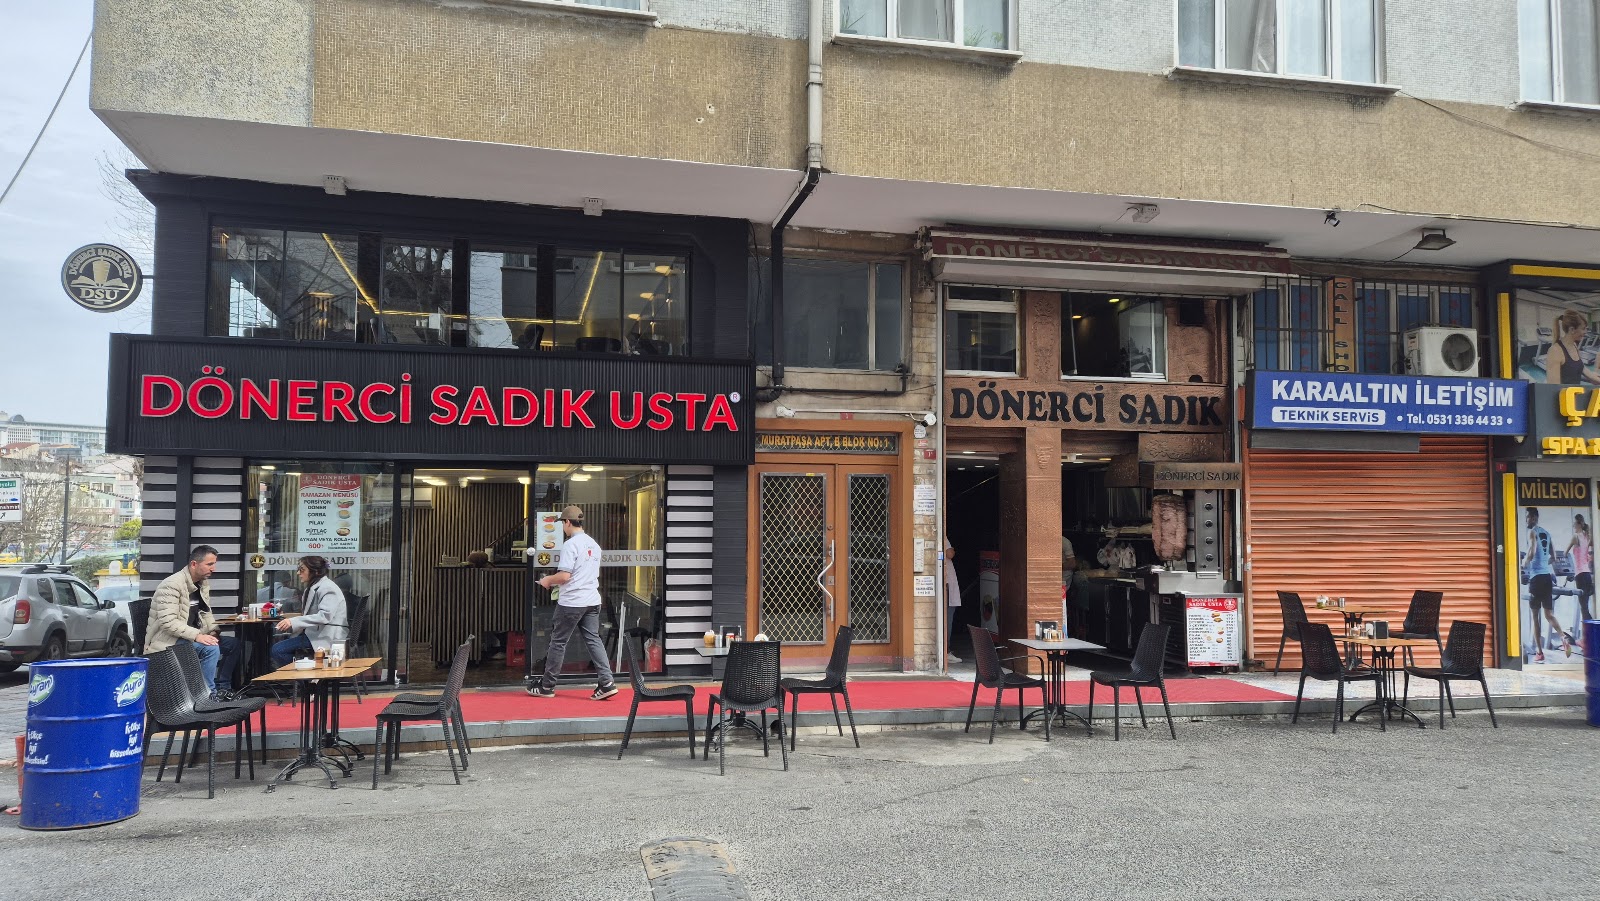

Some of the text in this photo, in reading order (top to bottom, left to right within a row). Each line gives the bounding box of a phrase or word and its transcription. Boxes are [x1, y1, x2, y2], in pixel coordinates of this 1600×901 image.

[80, 288, 119, 300] DSU
[1334, 281, 1348, 324] CALL
[140, 365, 412, 426] DÖNERCİ
[429, 384, 596, 429] SADIK
[950, 380, 1223, 426] DÖNERCİ SADIK
[1271, 379, 1514, 412] KARAALTIN İLETİŞİM
[1406, 413, 1425, 424] Tel.
[1426, 414, 1452, 425] 0531
[1454, 414, 1474, 425] 336
[761, 434, 813, 449] MURATPAŞA
[834, 437, 840, 447] B
[842, 437, 866, 448] BLOK
[1542, 437, 1588, 455] SPA
[1156, 471, 1240, 481] DÖNERCİ SADIK
[1521, 479, 1587, 499] MİLENİO
[635, 553, 661, 562] USTA
